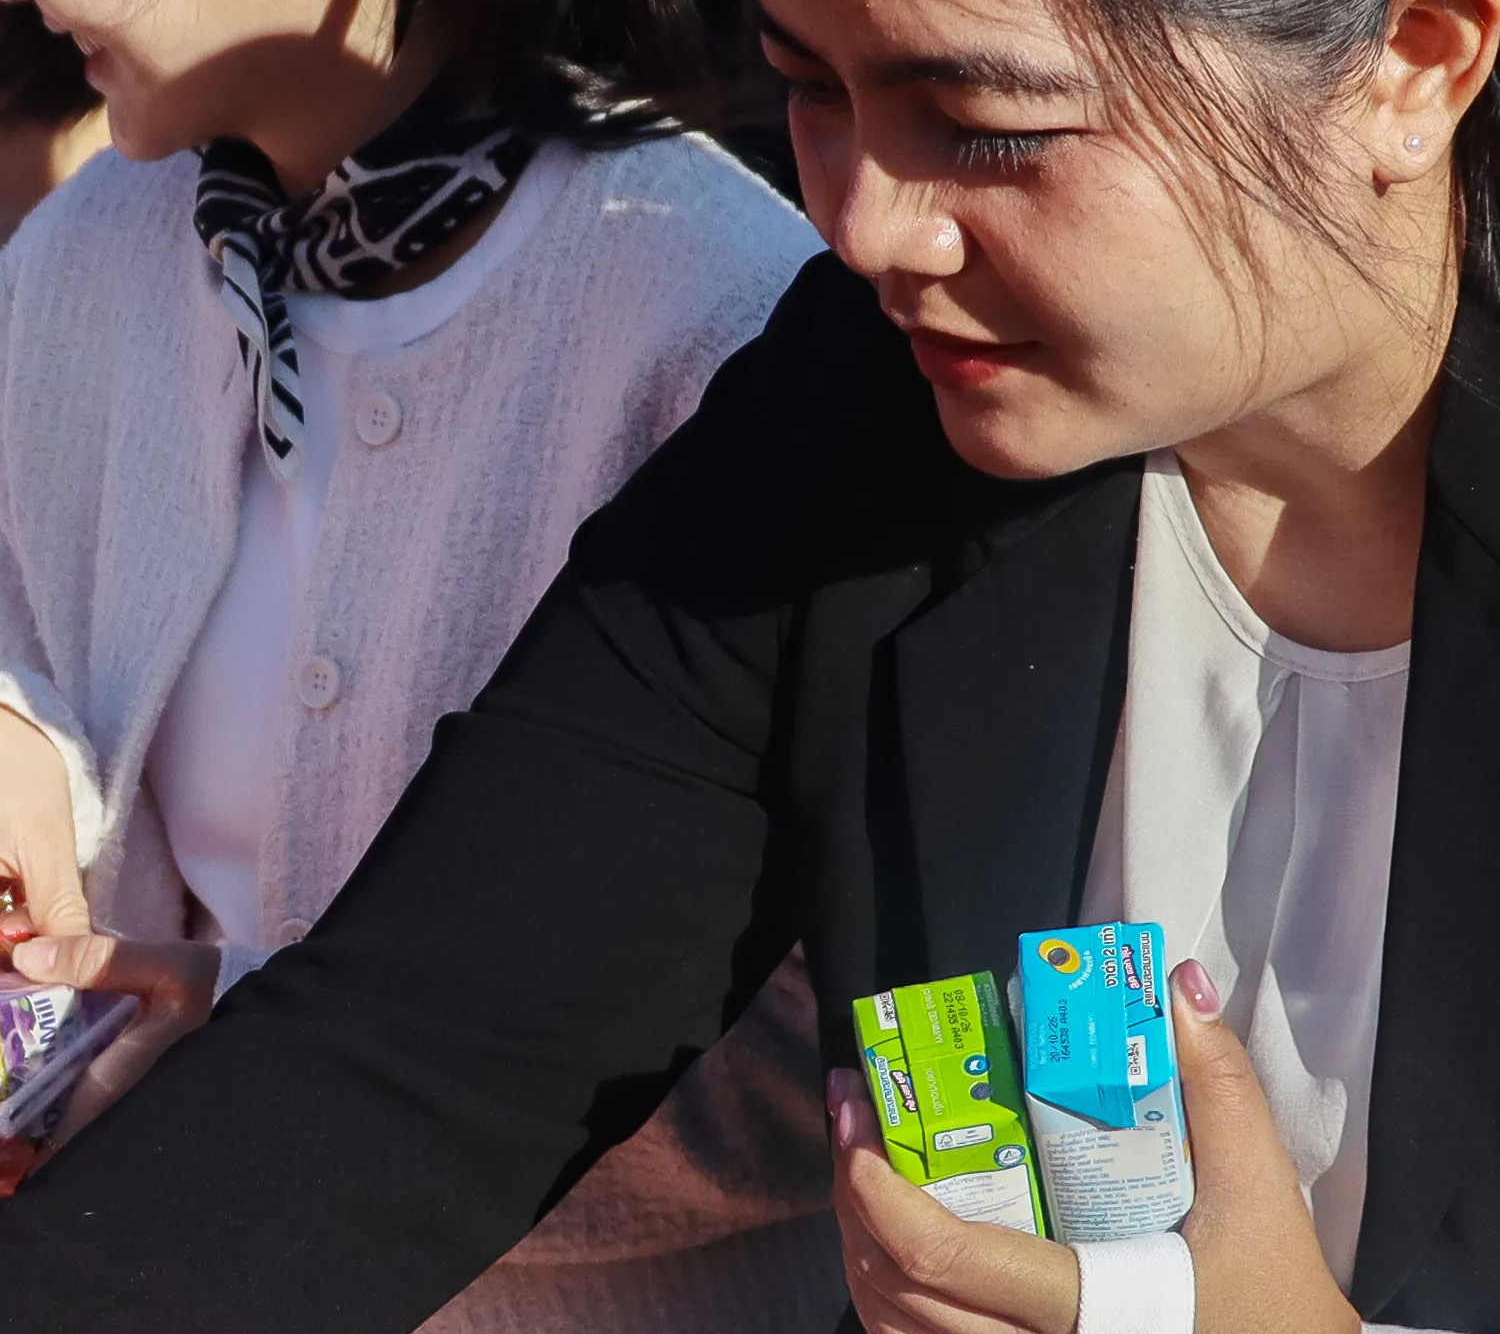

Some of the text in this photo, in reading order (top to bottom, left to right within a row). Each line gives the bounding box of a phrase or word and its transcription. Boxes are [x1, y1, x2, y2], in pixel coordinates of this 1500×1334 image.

[1098, 925, 1118, 988] งาดำ 2 เท่า
[1049, 1016, 1060, 1063] 20/10/26
